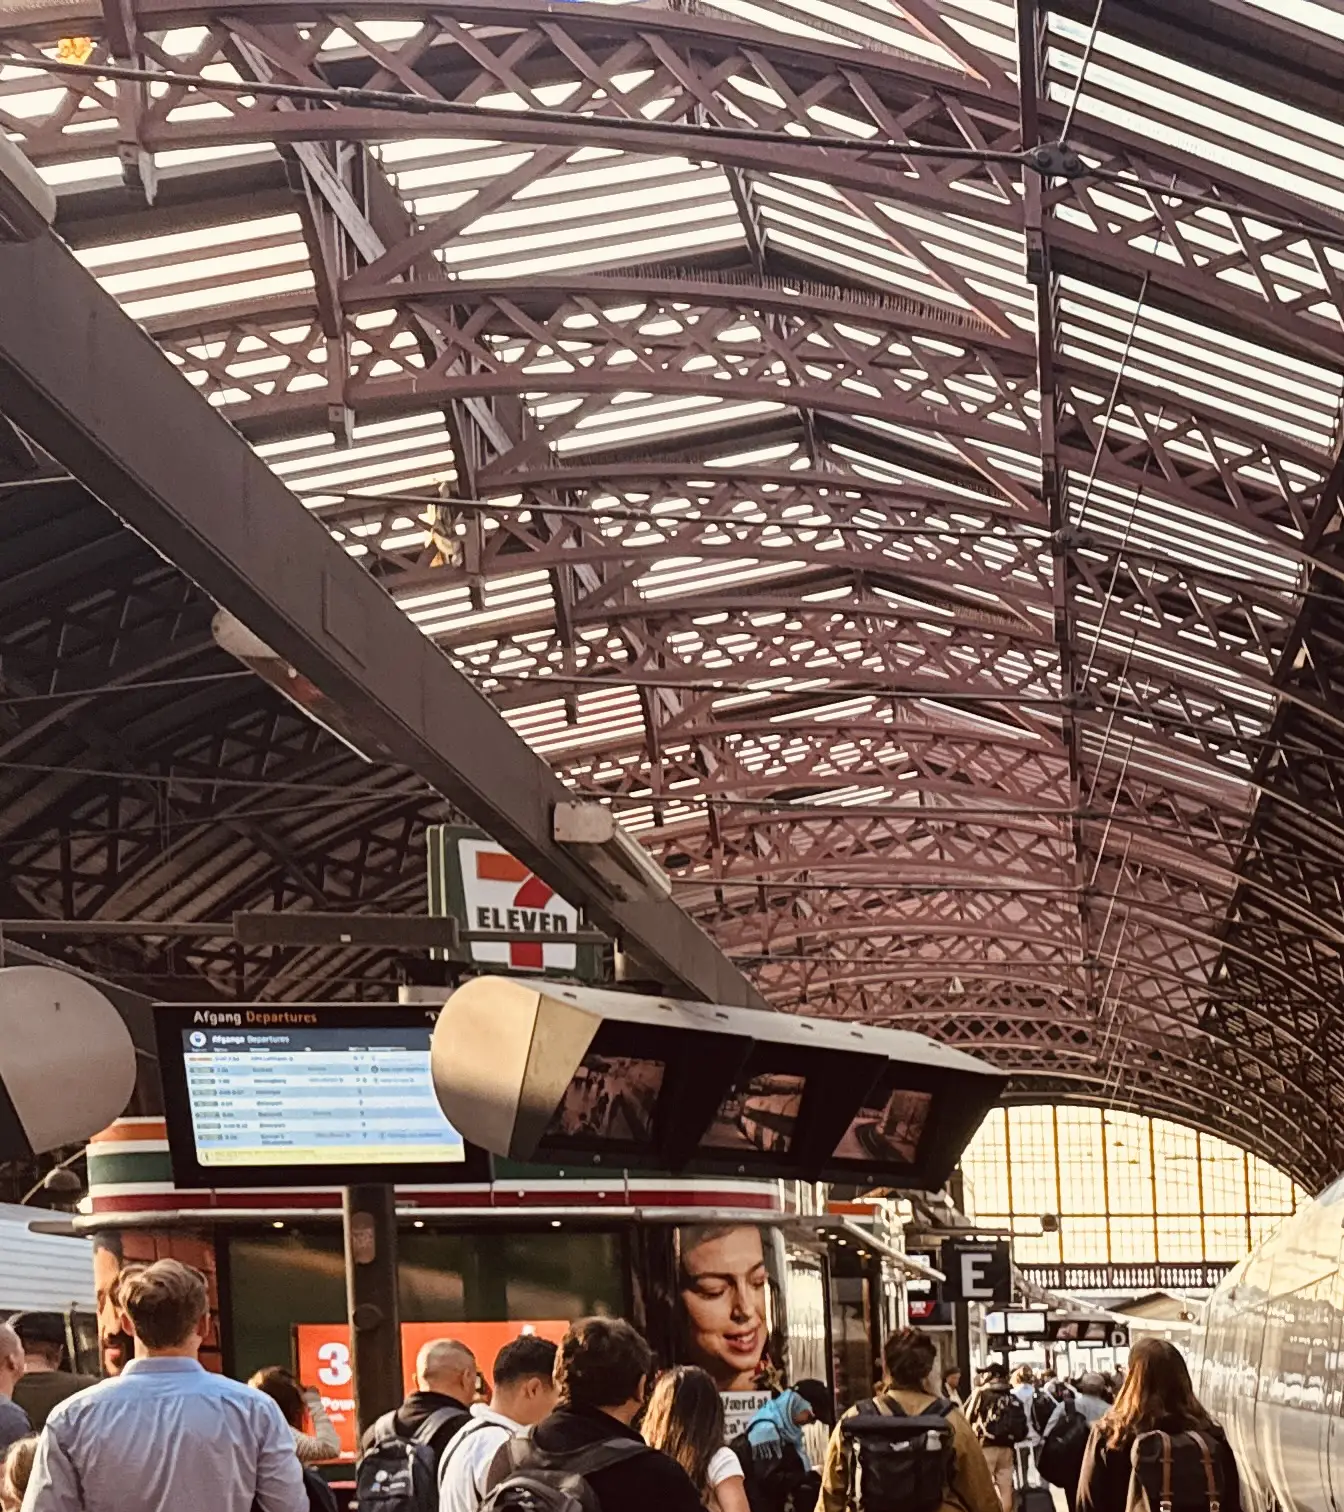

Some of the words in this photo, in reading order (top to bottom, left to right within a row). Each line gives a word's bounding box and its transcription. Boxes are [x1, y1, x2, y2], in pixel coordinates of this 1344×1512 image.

[193, 1010, 242, 1026] Afgang
[245, 1010, 318, 1026] Departures
[960, 1252, 994, 1299] E
[317, 1342, 353, 1386] 3
